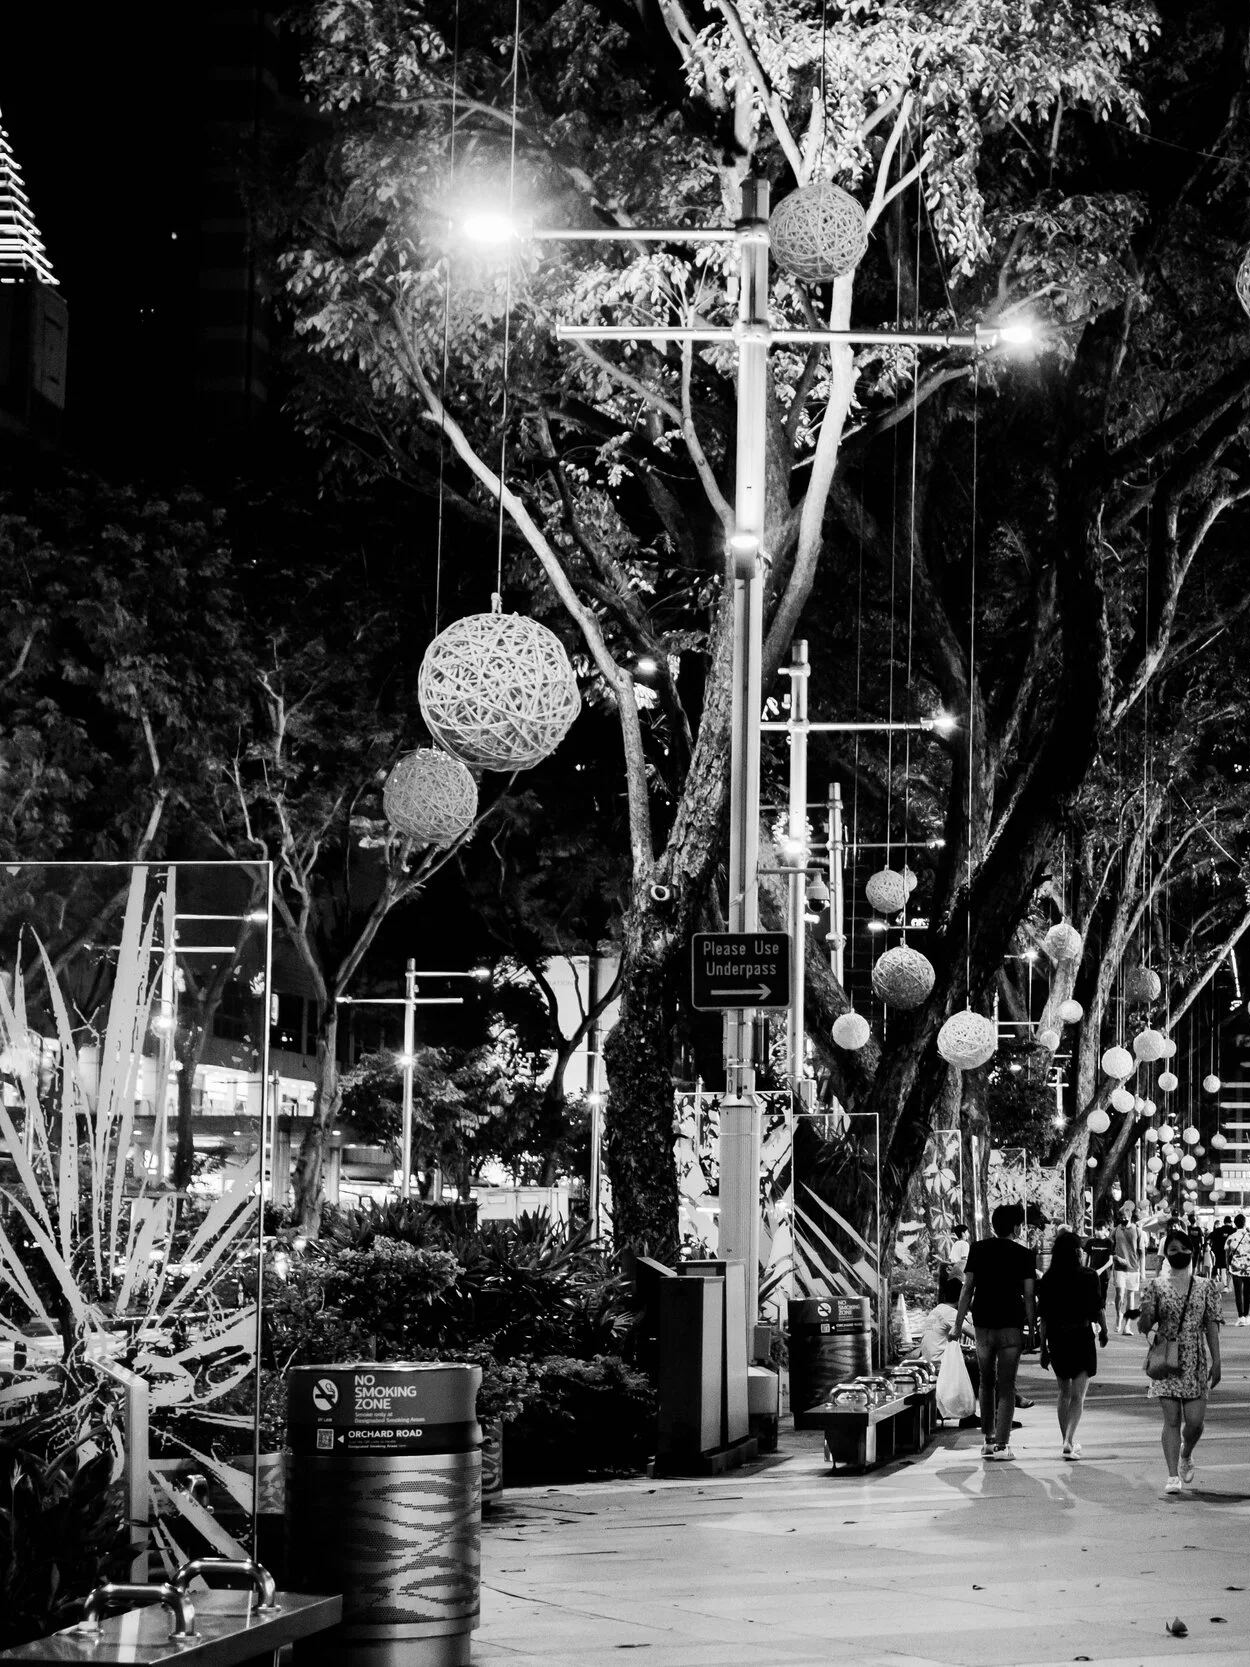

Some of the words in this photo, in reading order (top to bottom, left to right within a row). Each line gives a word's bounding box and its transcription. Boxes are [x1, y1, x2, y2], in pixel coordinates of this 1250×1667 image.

[703, 941, 747, 956] Please
[754, 940, 780, 955] Use
[706, 961, 777, 979] Underpass
[354, 1375, 376, 1386] NO
[354, 1386, 417, 1398] SMOKING
[354, 1398, 391, 1410] ZONE
[348, 1430, 394, 1438] ORCHARD
[396, 1429, 423, 1437] ROAD
